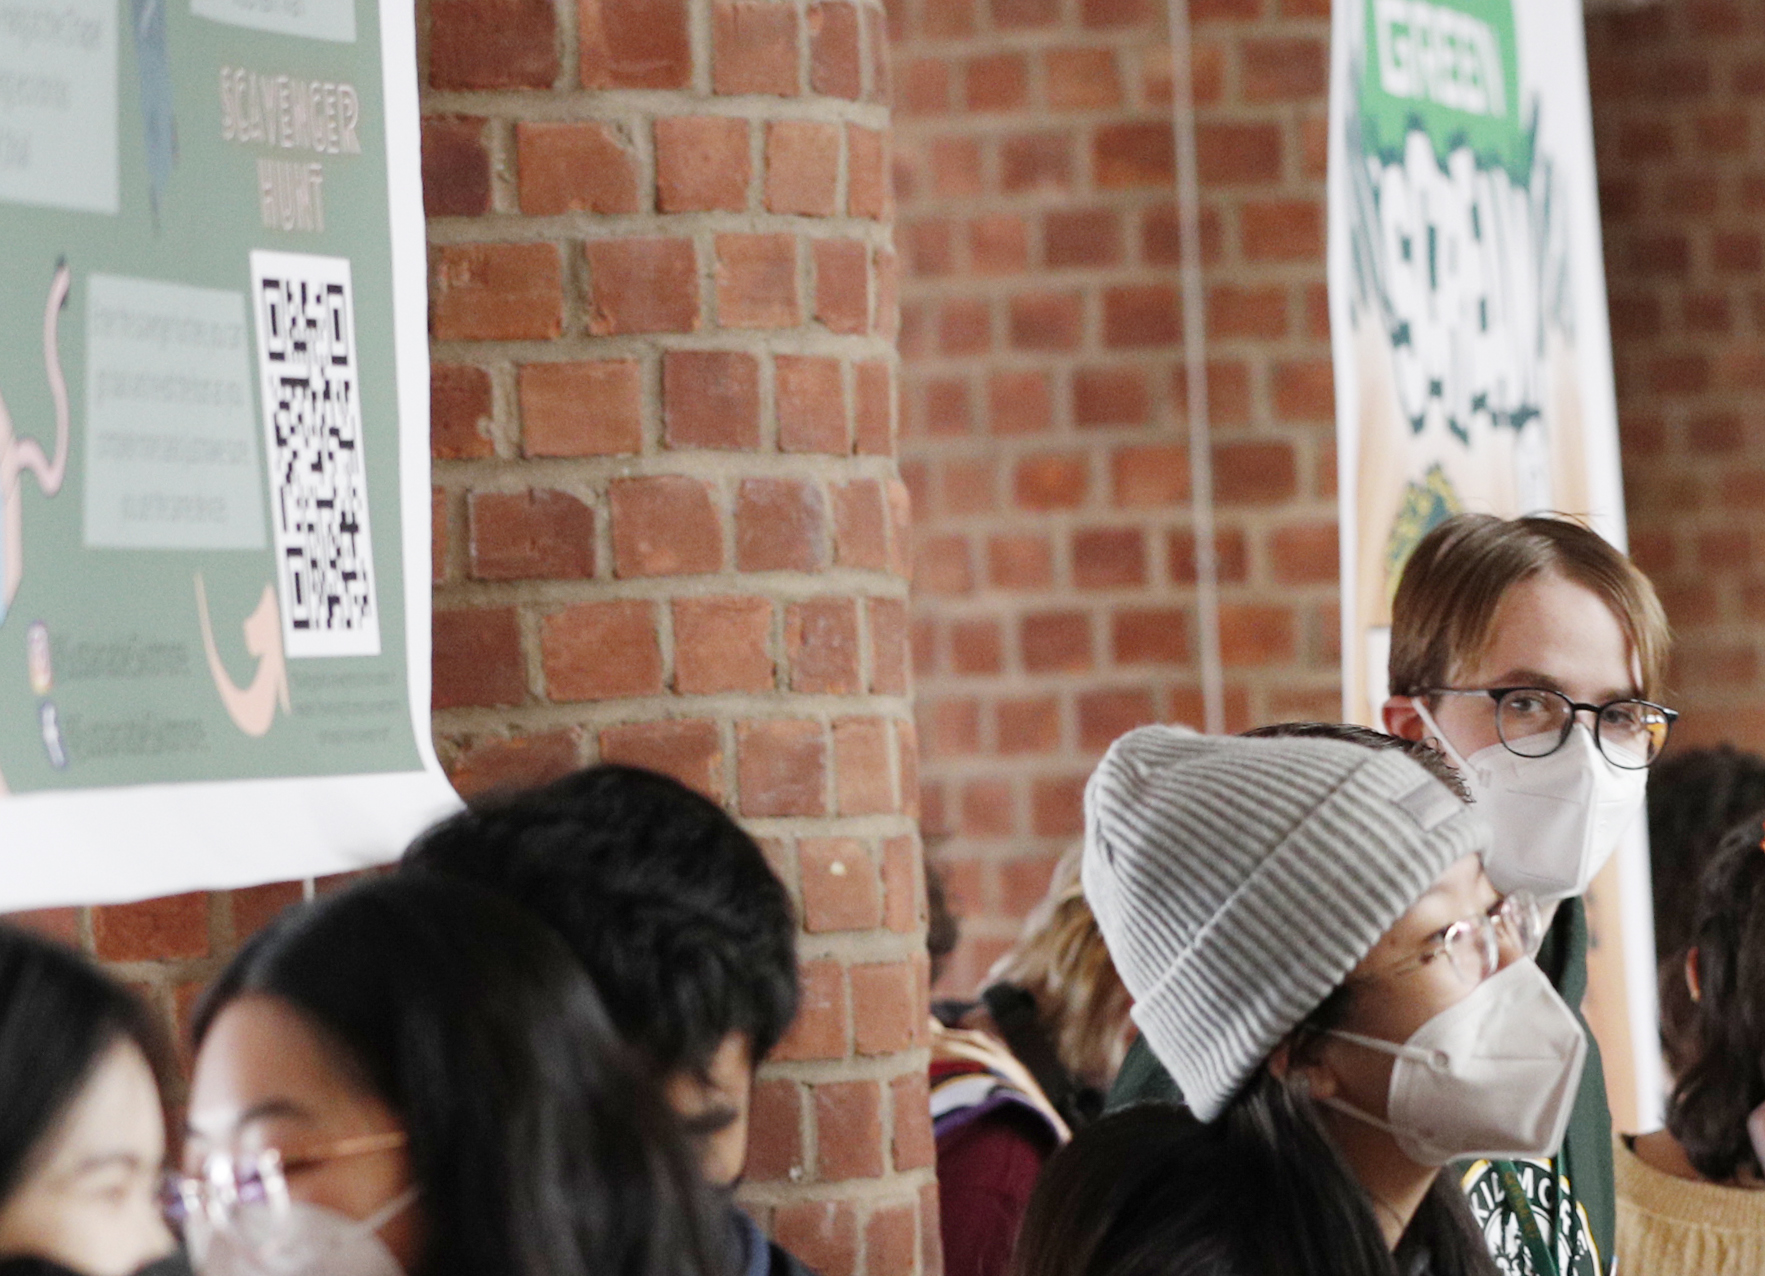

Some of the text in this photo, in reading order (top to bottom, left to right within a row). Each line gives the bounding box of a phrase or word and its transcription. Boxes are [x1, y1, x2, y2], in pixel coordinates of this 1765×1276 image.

[1375, 0, 1507, 118] GREEN
[218, 65, 361, 155] SCAVENGER
[256, 158, 324, 233] HUNT
